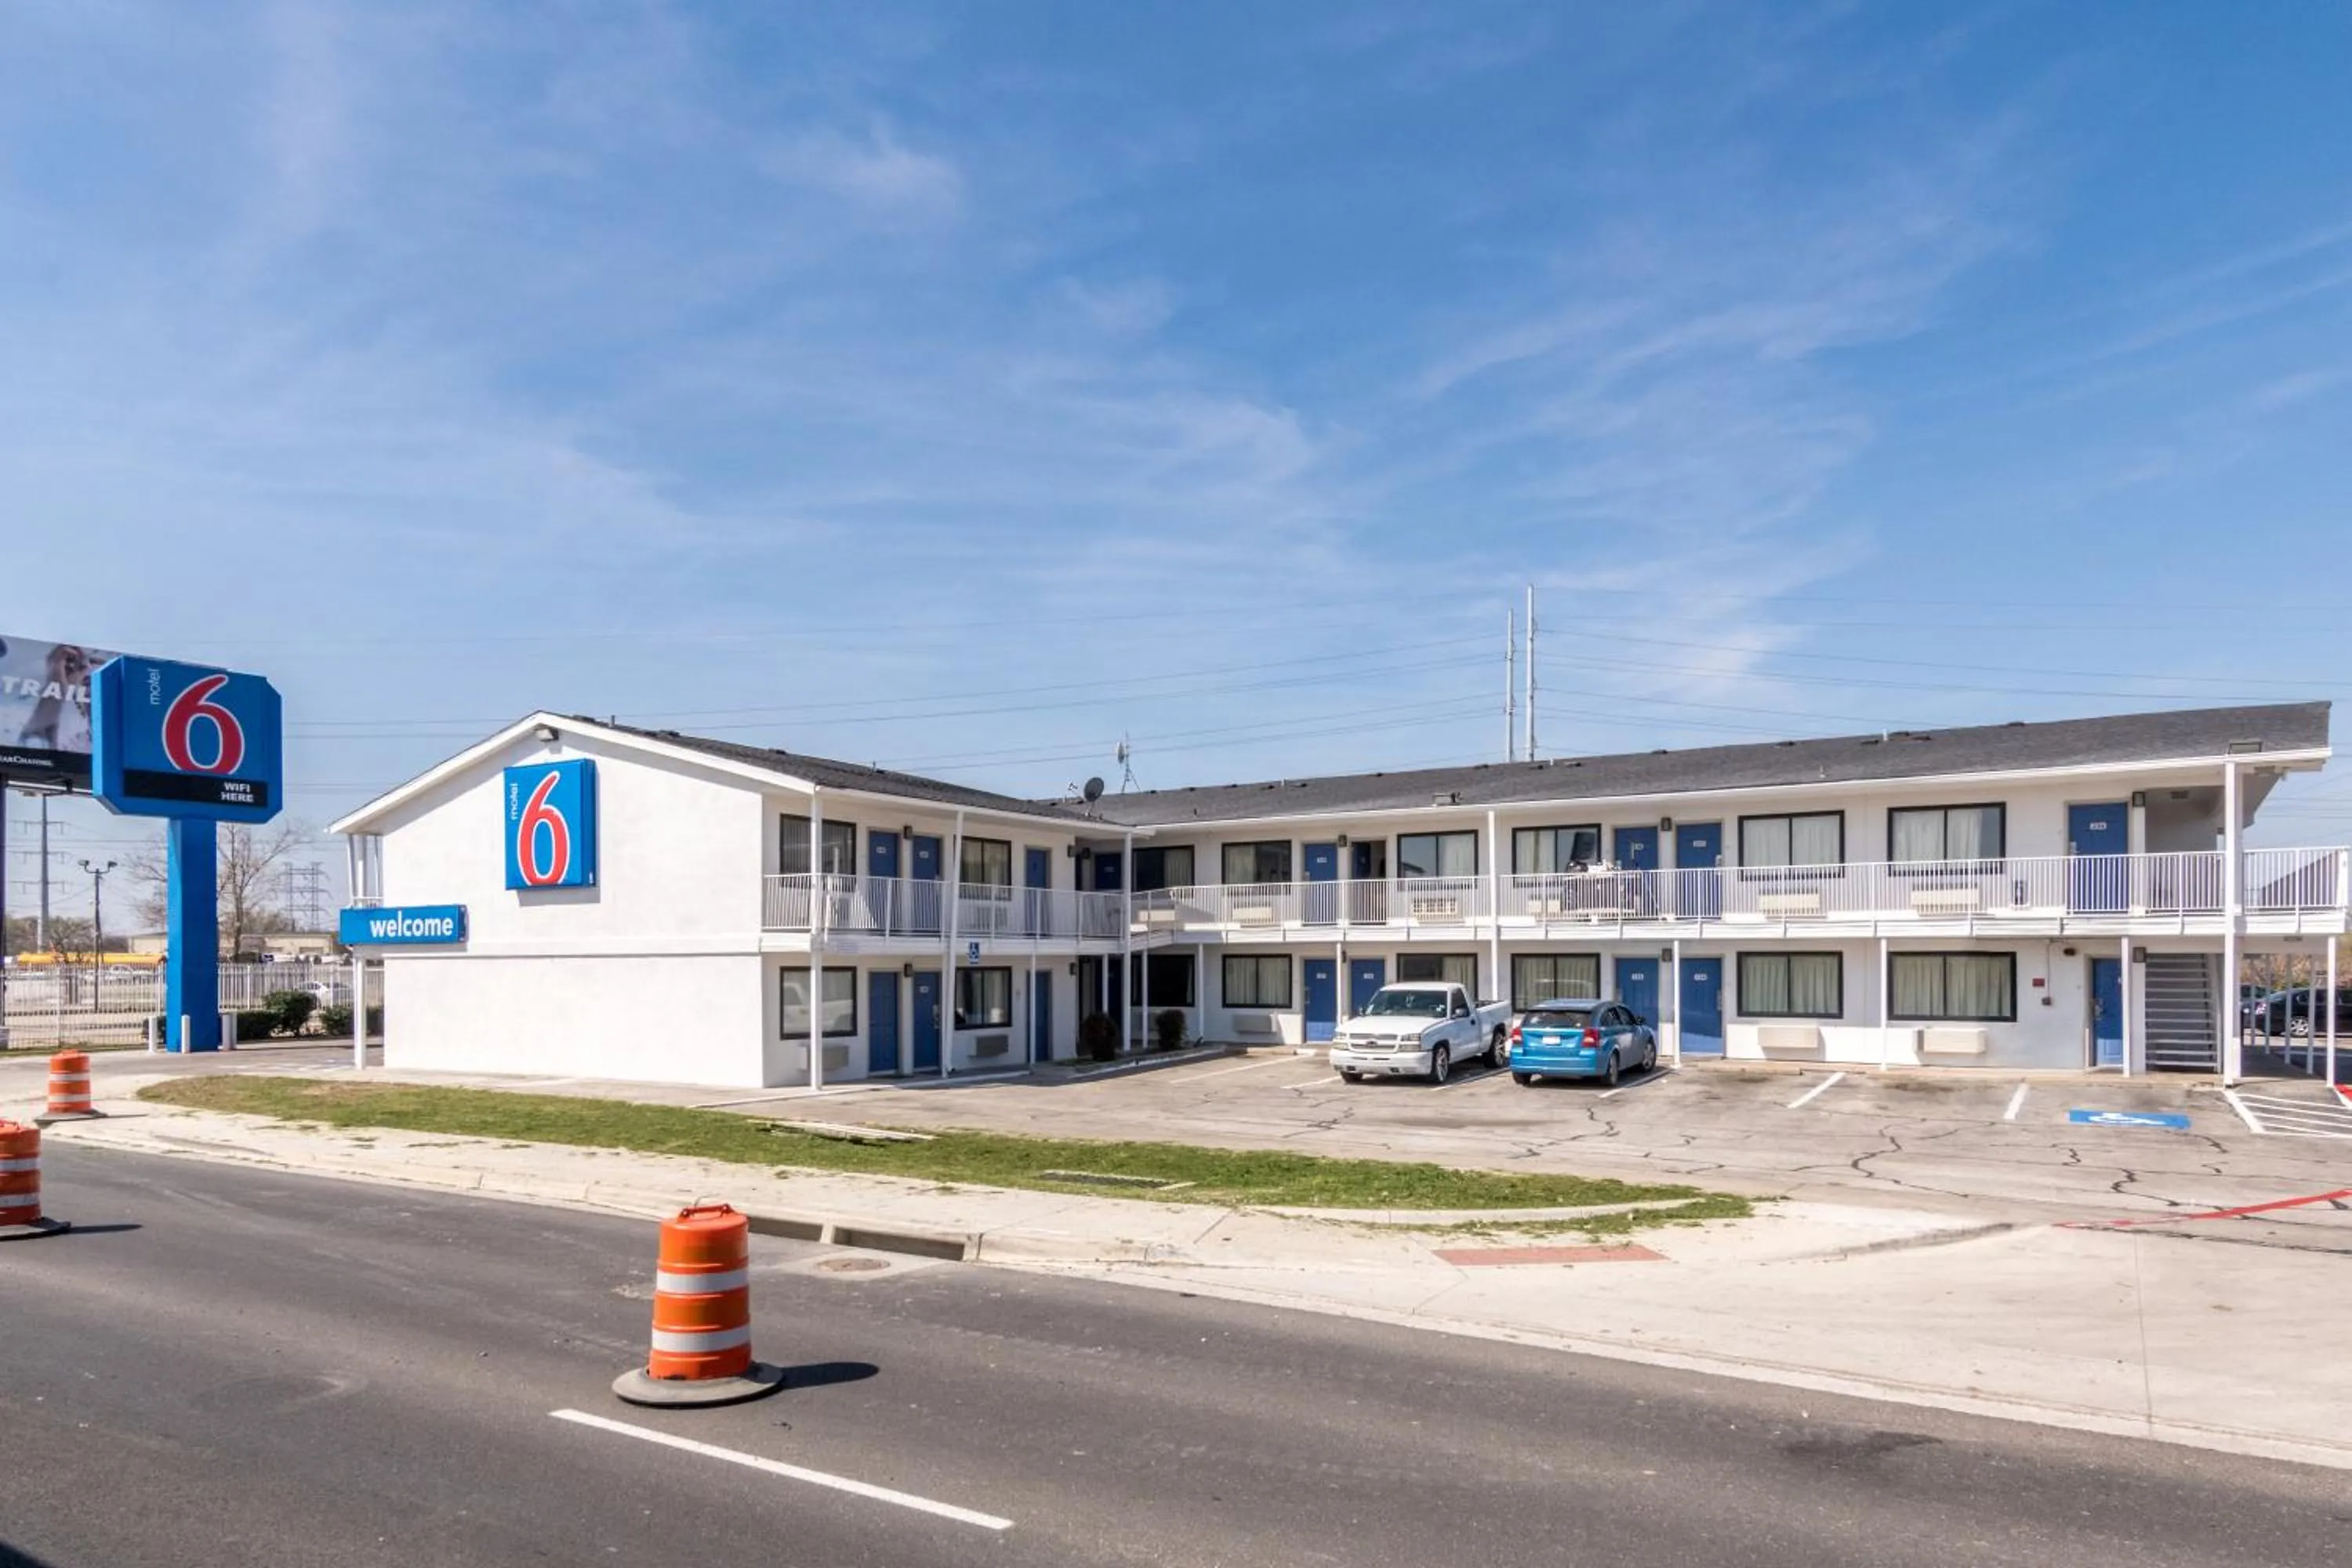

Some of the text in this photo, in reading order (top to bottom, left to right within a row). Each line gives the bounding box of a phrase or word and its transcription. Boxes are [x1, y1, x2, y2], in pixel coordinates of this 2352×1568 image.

[2, 675, 91, 703] TRAIL
[147, 668, 162, 705] motel
[162, 673, 245, 775] 6
[220, 791, 254, 803] HERE
[224, 782, 251, 793] WIFI
[510, 782, 519, 821] motel
[517, 771, 571, 886] 6
[370, 910, 454, 938] welcome
